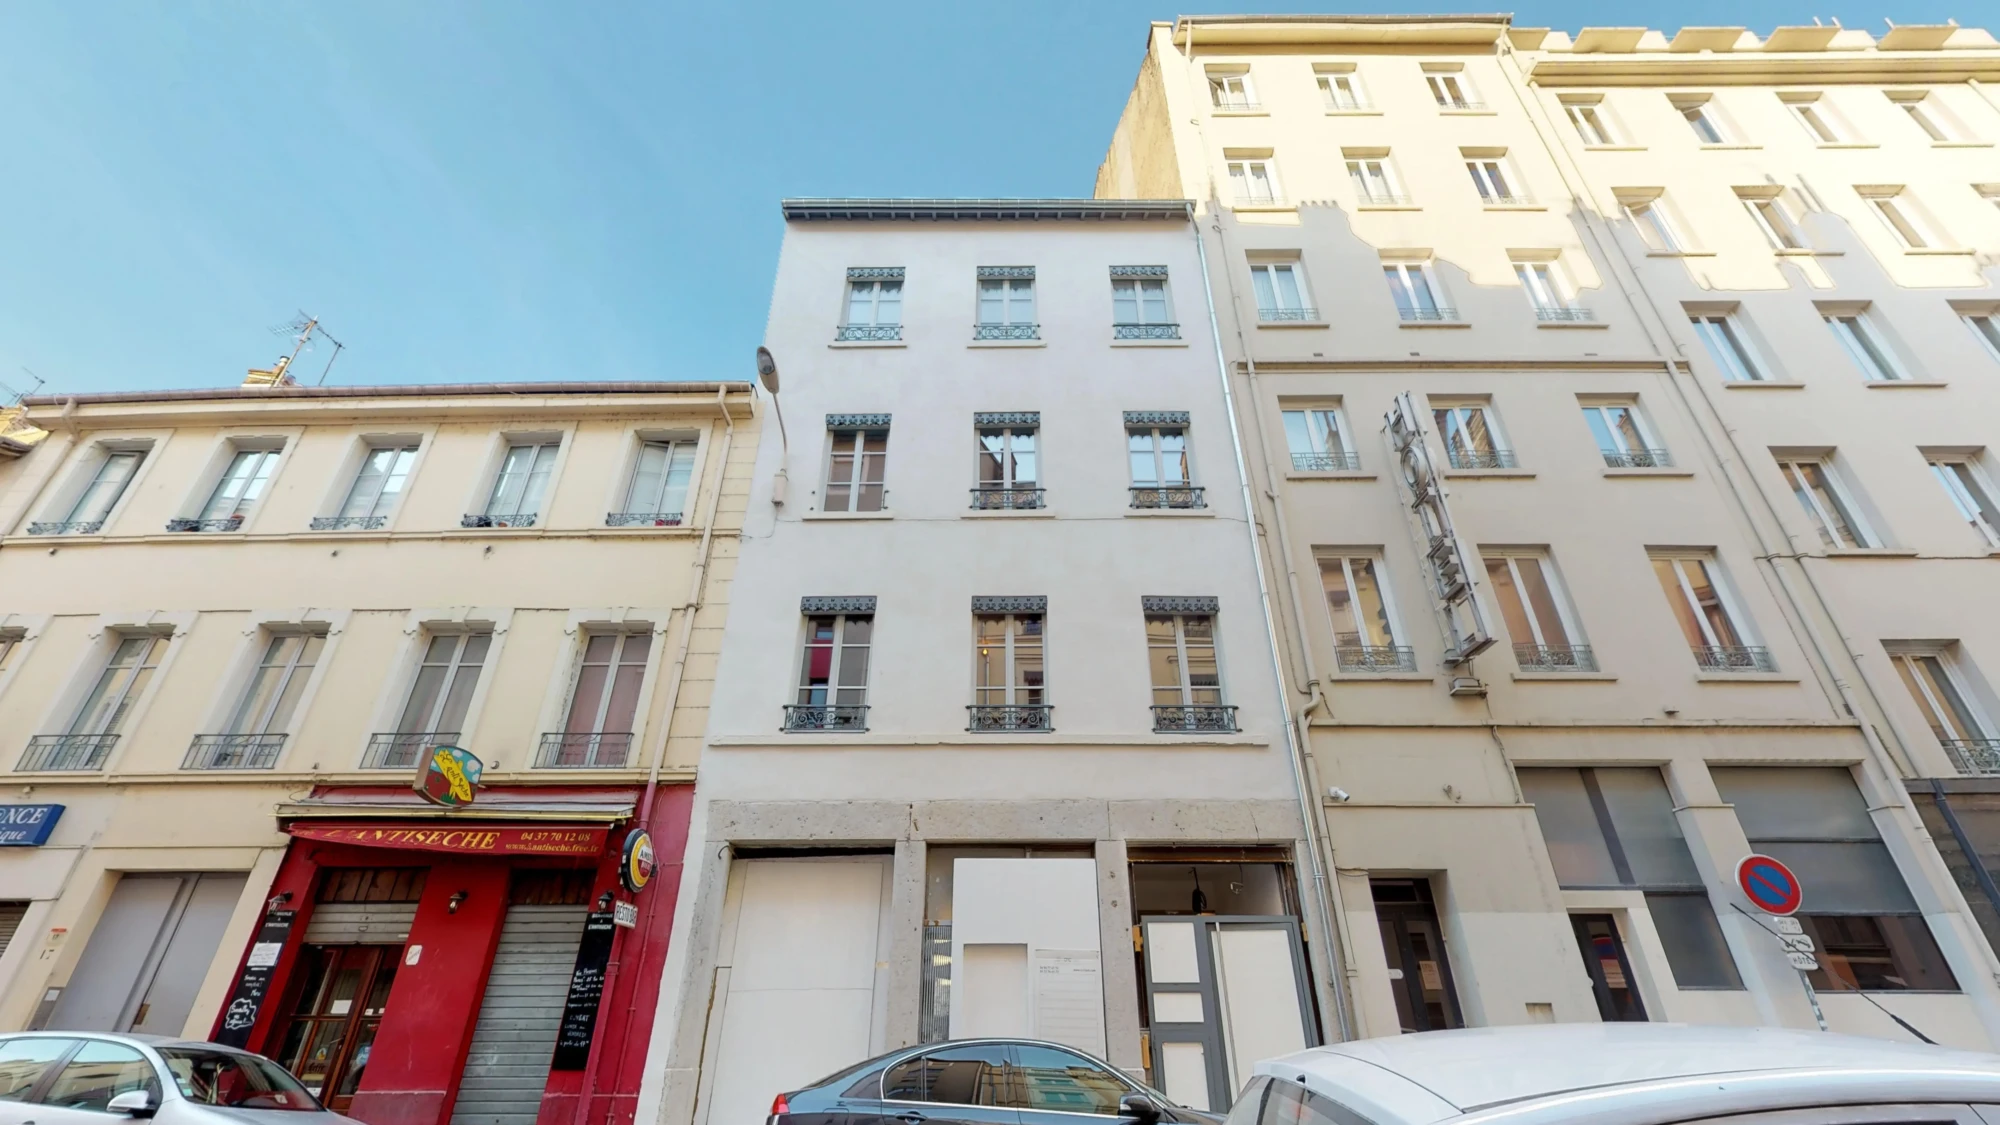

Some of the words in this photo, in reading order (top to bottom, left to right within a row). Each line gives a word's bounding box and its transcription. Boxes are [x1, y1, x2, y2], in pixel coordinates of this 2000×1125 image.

[0, 807, 48, 824] NCE
[520, 832, 534, 841] 04
[534, 832, 548, 841] 37
[550, 832, 562, 841] 70
[564, 832, 577, 841] 12
[578, 832, 591, 842] 08
